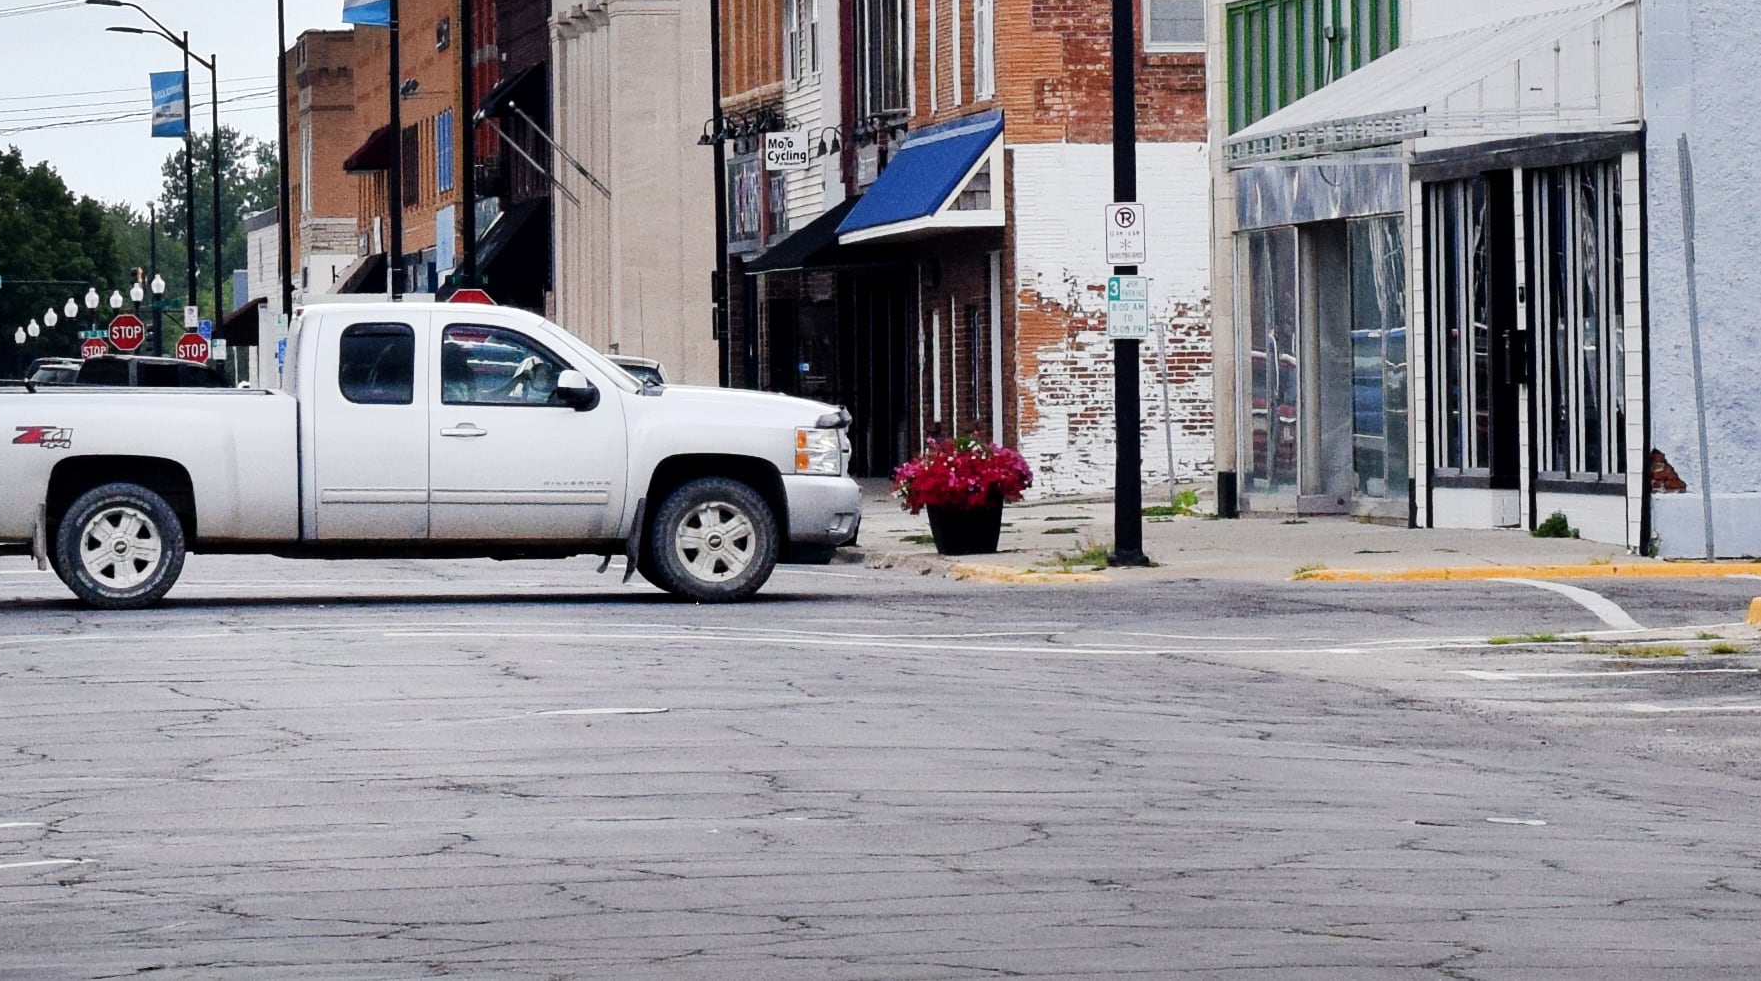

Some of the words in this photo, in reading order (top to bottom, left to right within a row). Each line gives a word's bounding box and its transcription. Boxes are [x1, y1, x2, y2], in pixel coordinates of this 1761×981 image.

[767, 151, 807, 164] Cycling
[1110, 281, 1119, 296] 3
[1133, 303, 1144, 311] AM
[112, 325, 142, 340] STOP
[1134, 325, 1144, 333] PM
[83, 345, 107, 357] STOP
[178, 343, 207, 358] STOP
[12, 425, 74, 445] Z71
